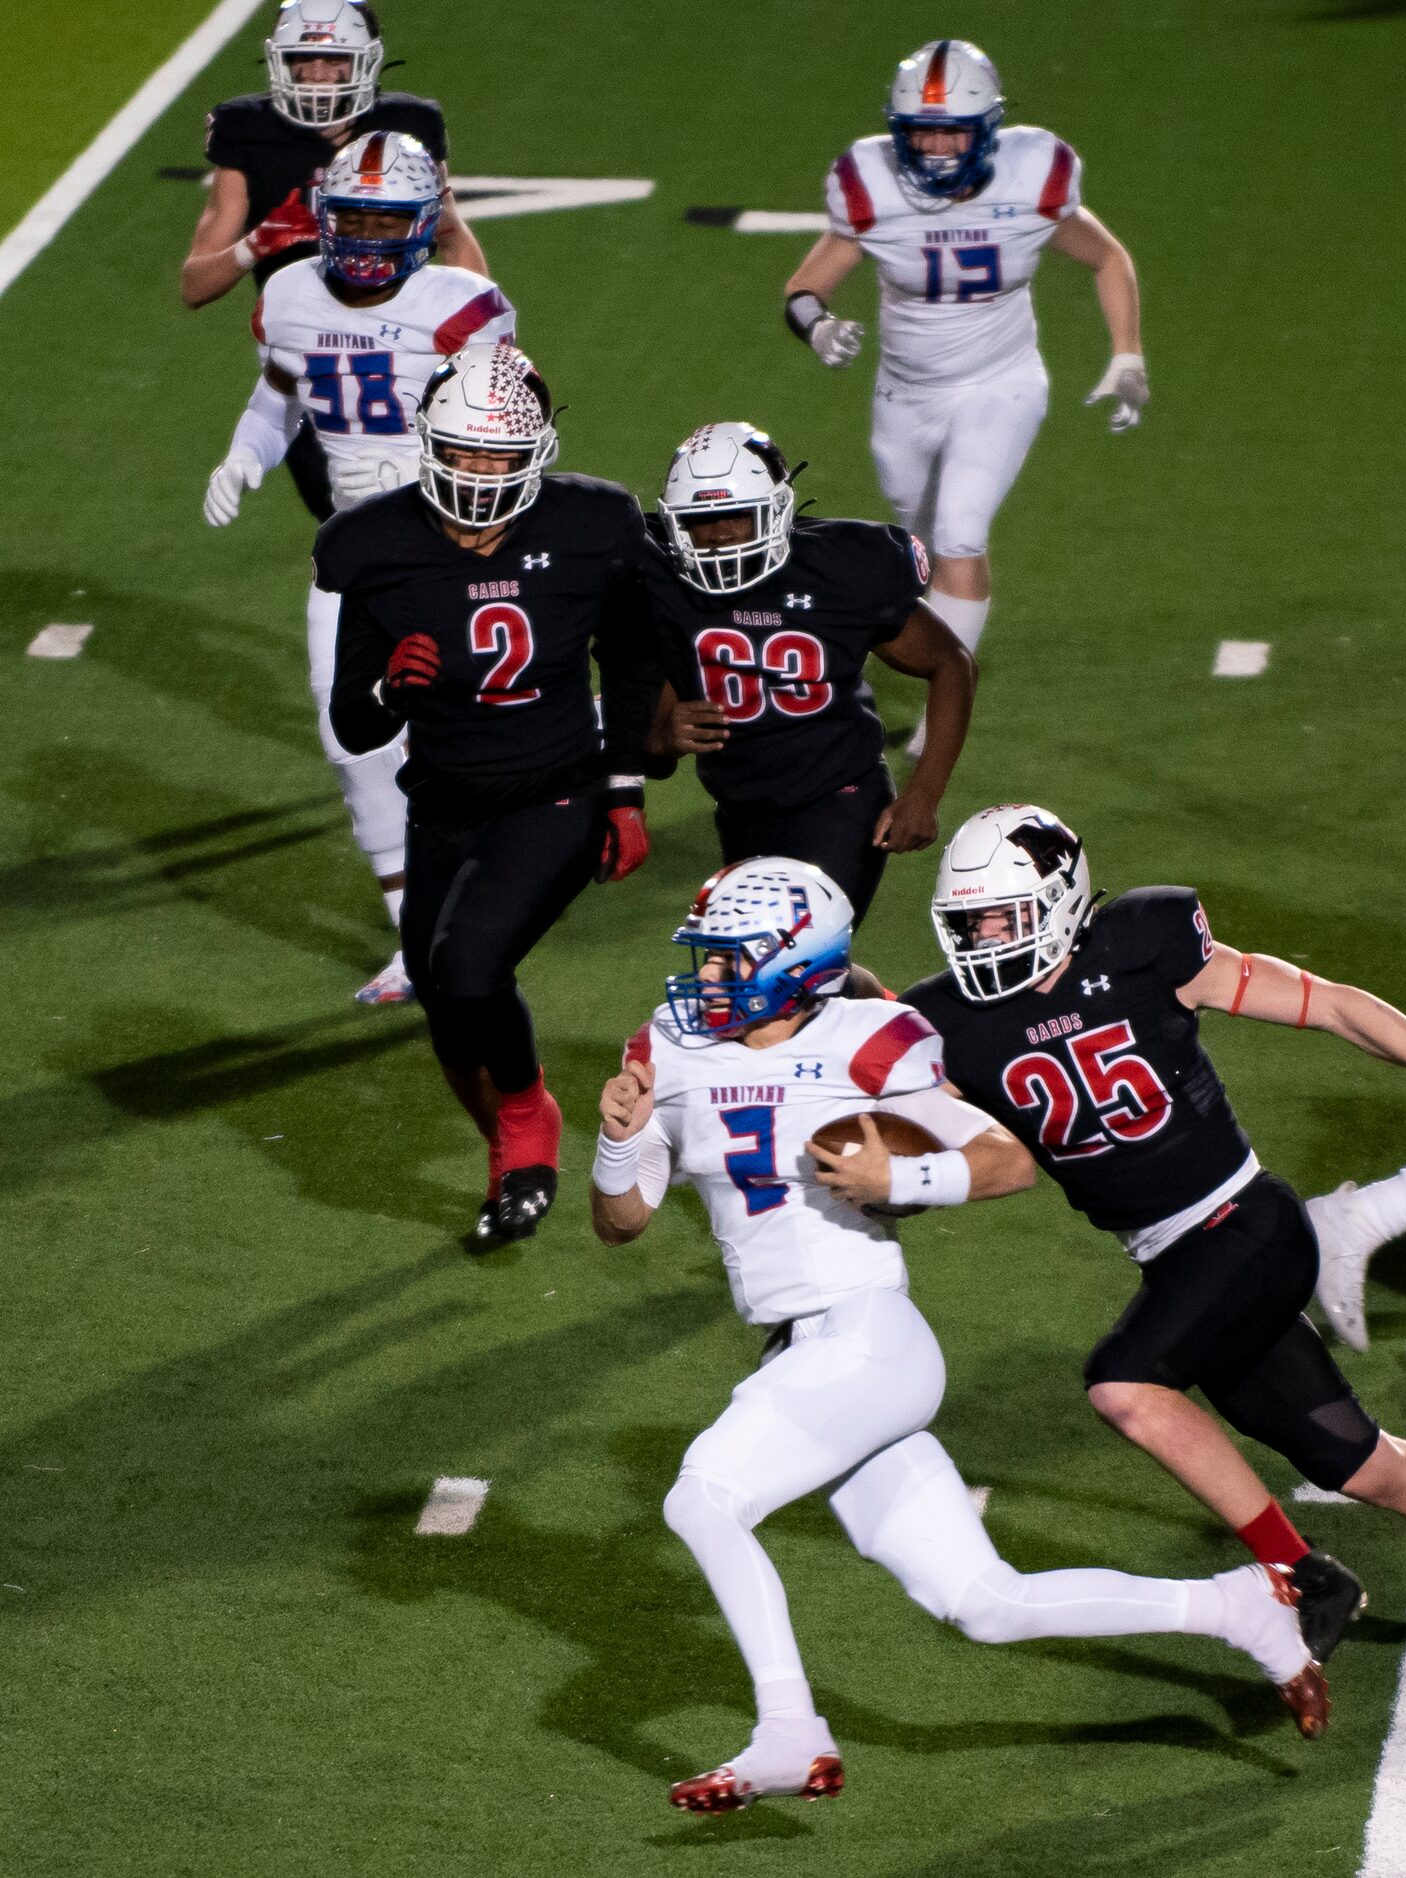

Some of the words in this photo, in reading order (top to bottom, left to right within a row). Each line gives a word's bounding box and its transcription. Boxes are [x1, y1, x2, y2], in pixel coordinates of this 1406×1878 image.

[920, 244, 1003, 304] 12
[466, 423, 501, 435] Riddell
[468, 580, 520, 600] CARDS
[733, 610, 782, 627] CARDS
[470, 602, 541, 706] 2
[695, 628, 832, 723] 63
[1026, 1012, 1084, 1045] CARDS
[1002, 1019, 1174, 1162] 25
[719, 1105, 790, 1217] 2
